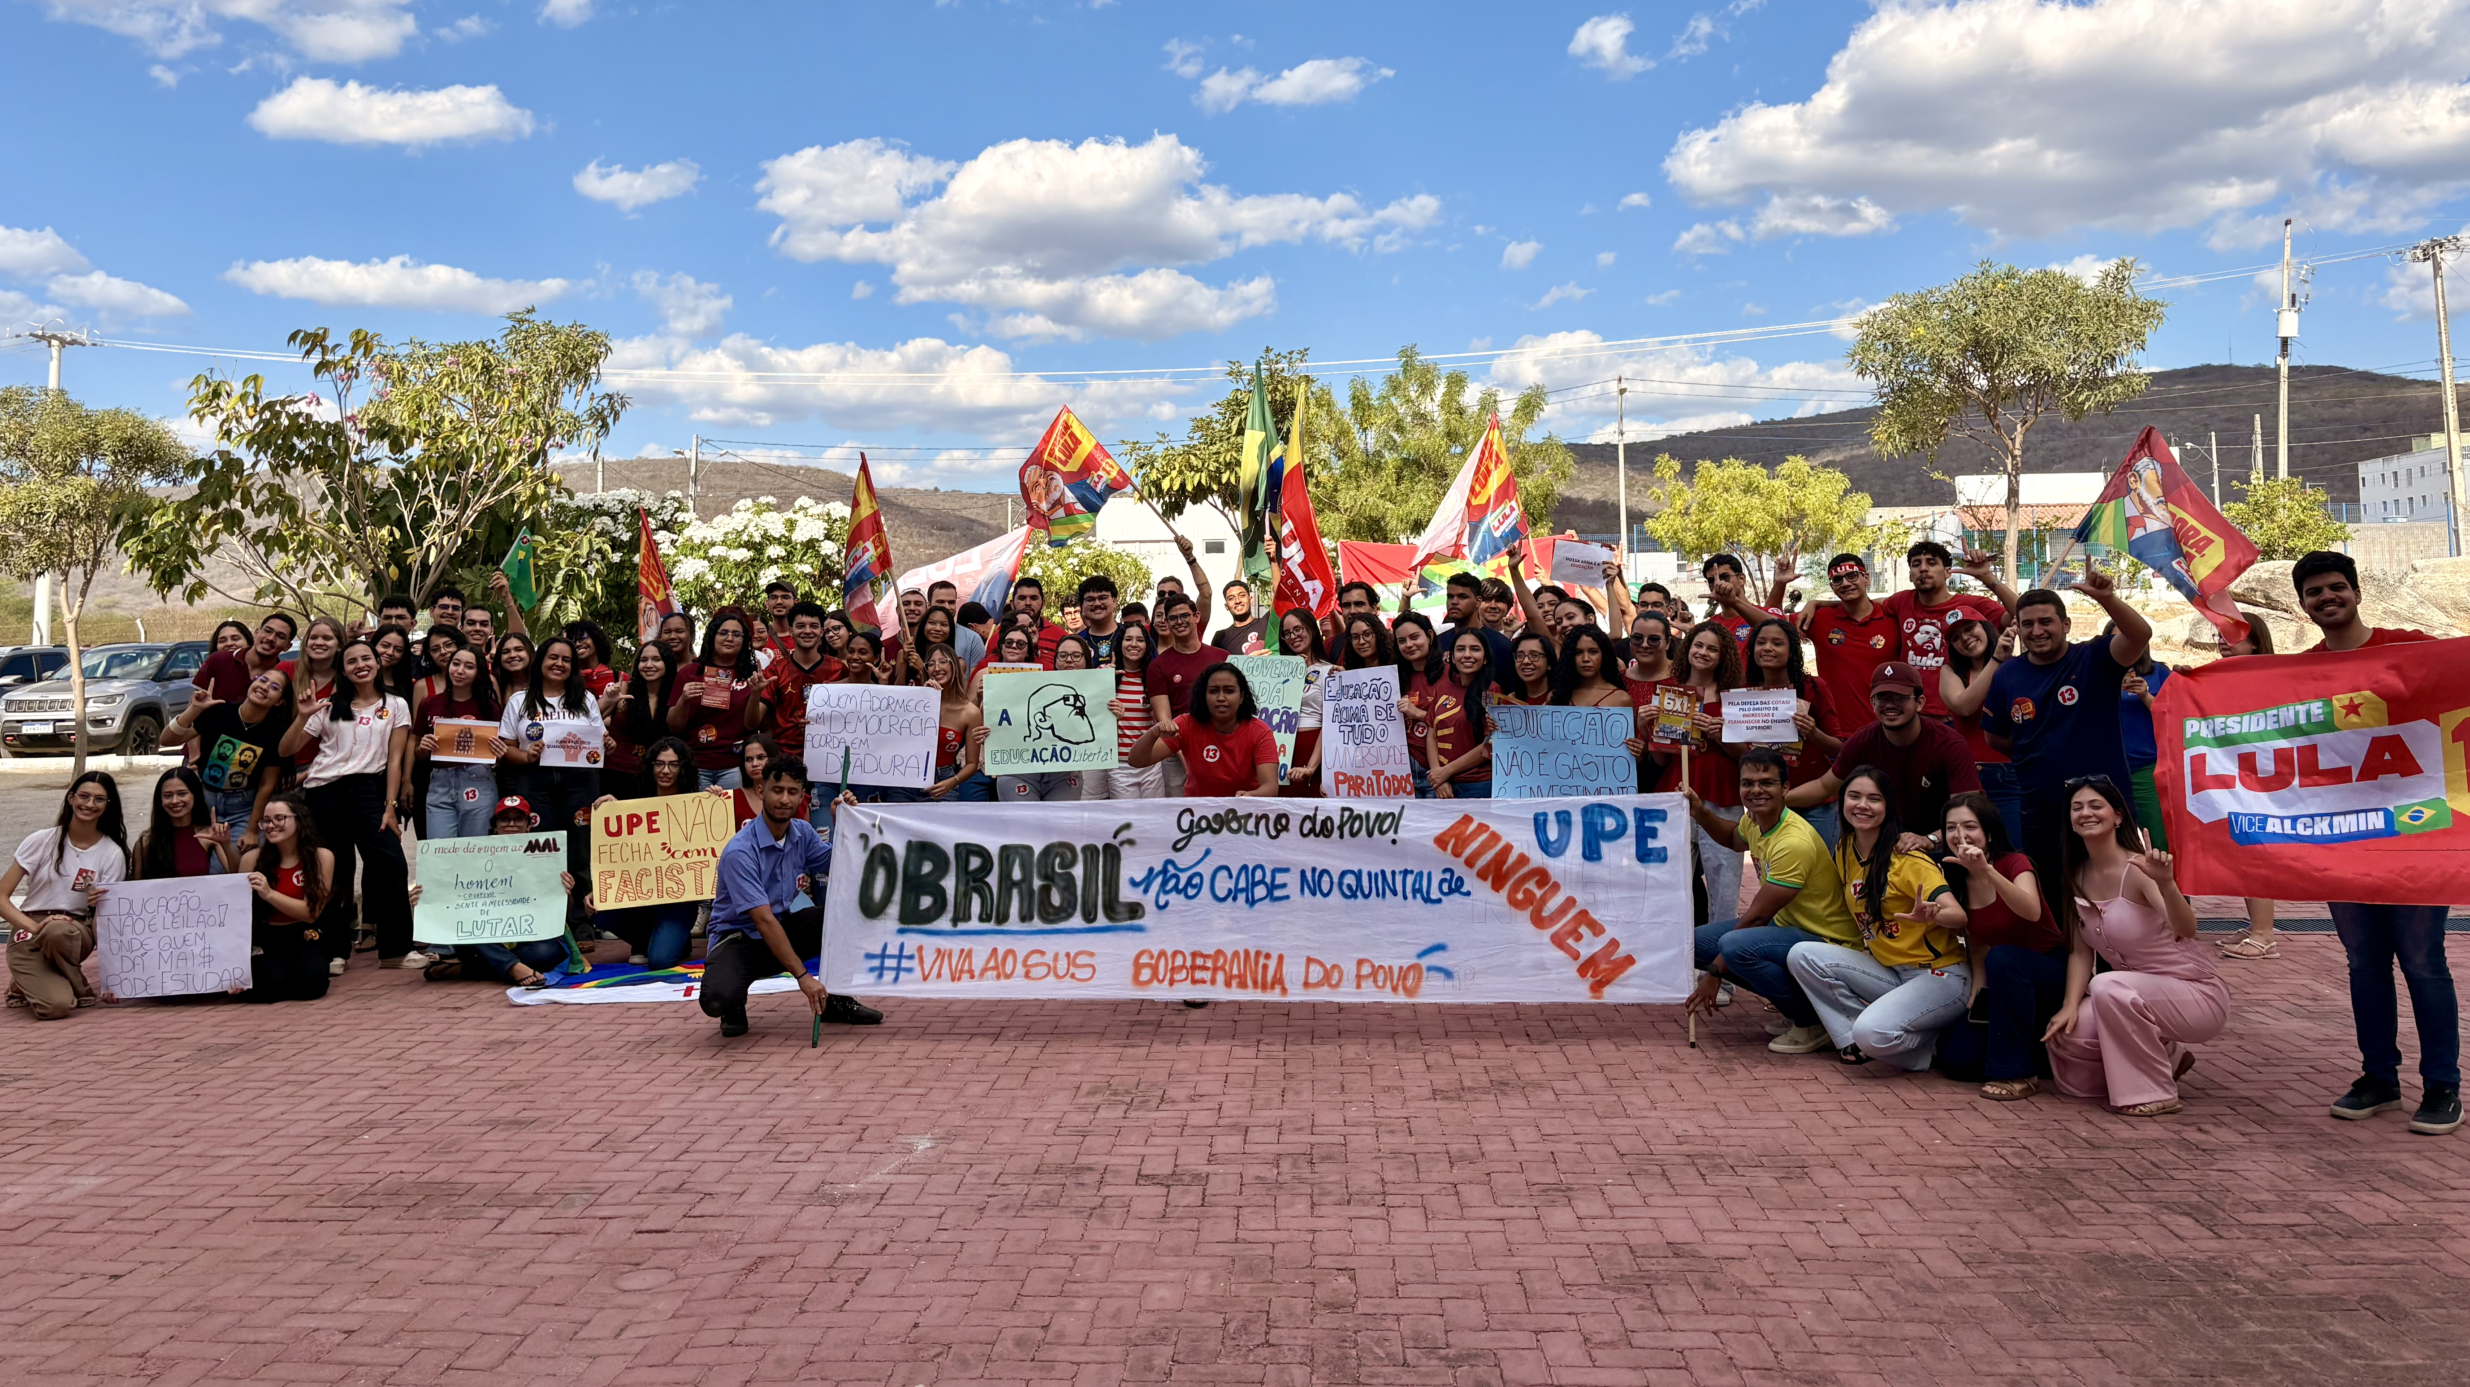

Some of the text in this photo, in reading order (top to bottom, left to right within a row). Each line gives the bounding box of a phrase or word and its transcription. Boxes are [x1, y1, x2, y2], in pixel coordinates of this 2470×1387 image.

[1055, 430, 1083, 468] LULA
[1470, 451, 1504, 500] LULA
[1492, 504, 1516, 533] LULA
[2171, 512, 2216, 557] ORA,
[1281, 519, 1325, 612] ULA
[1565, 556, 1580, 564] NOSSA
[1570, 563, 1594, 571] EDUCAÇÃO
[1832, 564, 1860, 576] LULA
[1904, 621, 1914, 631] 13
[1242, 657, 1306, 680] GOVERNO
[813, 686, 931, 713] QUEM ADORMECE
[2059, 687, 2076, 704] 13
[358, 716, 372, 726] 13
[806, 708, 937, 737] EM DEMOCRACIA
[997, 708, 1013, 727] A
[1258, 706, 1299, 735] AÇÃO
[1331, 703, 1397, 724] ACIMA DE
[2185, 701, 2324, 739] PRESIDENTE
[1338, 723, 1389, 746] TUDO
[1415, 725, 1427, 735] 13
[1490, 706, 1629, 749] EDUCAÇÃO
[805, 733, 870, 750] ACORDA EM
[1205, 748, 1218, 760] 13
[825, 750, 930, 782] DIADURA!
[990, 744, 1072, 765] EDUCAÇÃO
[1323, 744, 1409, 770] UNIVERSIDADE
[1495, 746, 1631, 783] NÃO É GASTO
[2190, 734, 2425, 796] LULA
[2451, 716, 2470, 794] 1
[465, 789, 477, 801] 13
[1017, 784, 1028, 794] 13
[604, 794, 729, 846] UPE NÃO
[1299, 806, 1335, 839] do
[2231, 810, 2385, 836] VICE ALCKMIN
[1533, 802, 1668, 865] UPE
[420, 842, 430, 855] O
[462, 841, 476, 855] dá
[477, 844, 509, 857] origem
[523, 837, 561, 854] MAL
[598, 842, 654, 865] FECHA
[484, 859, 494, 873] O
[454, 873, 514, 891] homem
[598, 859, 720, 904] FACIST
[1209, 863, 1292, 908] CABE
[1299, 866, 1334, 898] NO
[1337, 866, 1443, 905] QUINTAL
[1438, 867, 1473, 897] de
[97, 884, 202, 917] EDUCAÇÃO
[454, 902, 479, 910] SENTE
[489, 896, 530, 908] NECESSIDADE
[1432, 812, 1637, 999] NINGUEM
[15, 930, 29, 942] 13
[107, 913, 147, 937] NÃO
[147, 914, 158, 933] É
[456, 913, 535, 938] LUTAR
[1889, 922, 1900, 934] 13
[108, 931, 207, 956] ONDE QUEM
[120, 951, 148, 974] DÁ
[1021, 947, 1097, 983] SUS
[106, 966, 250, 997] PODE ESTUDAR
